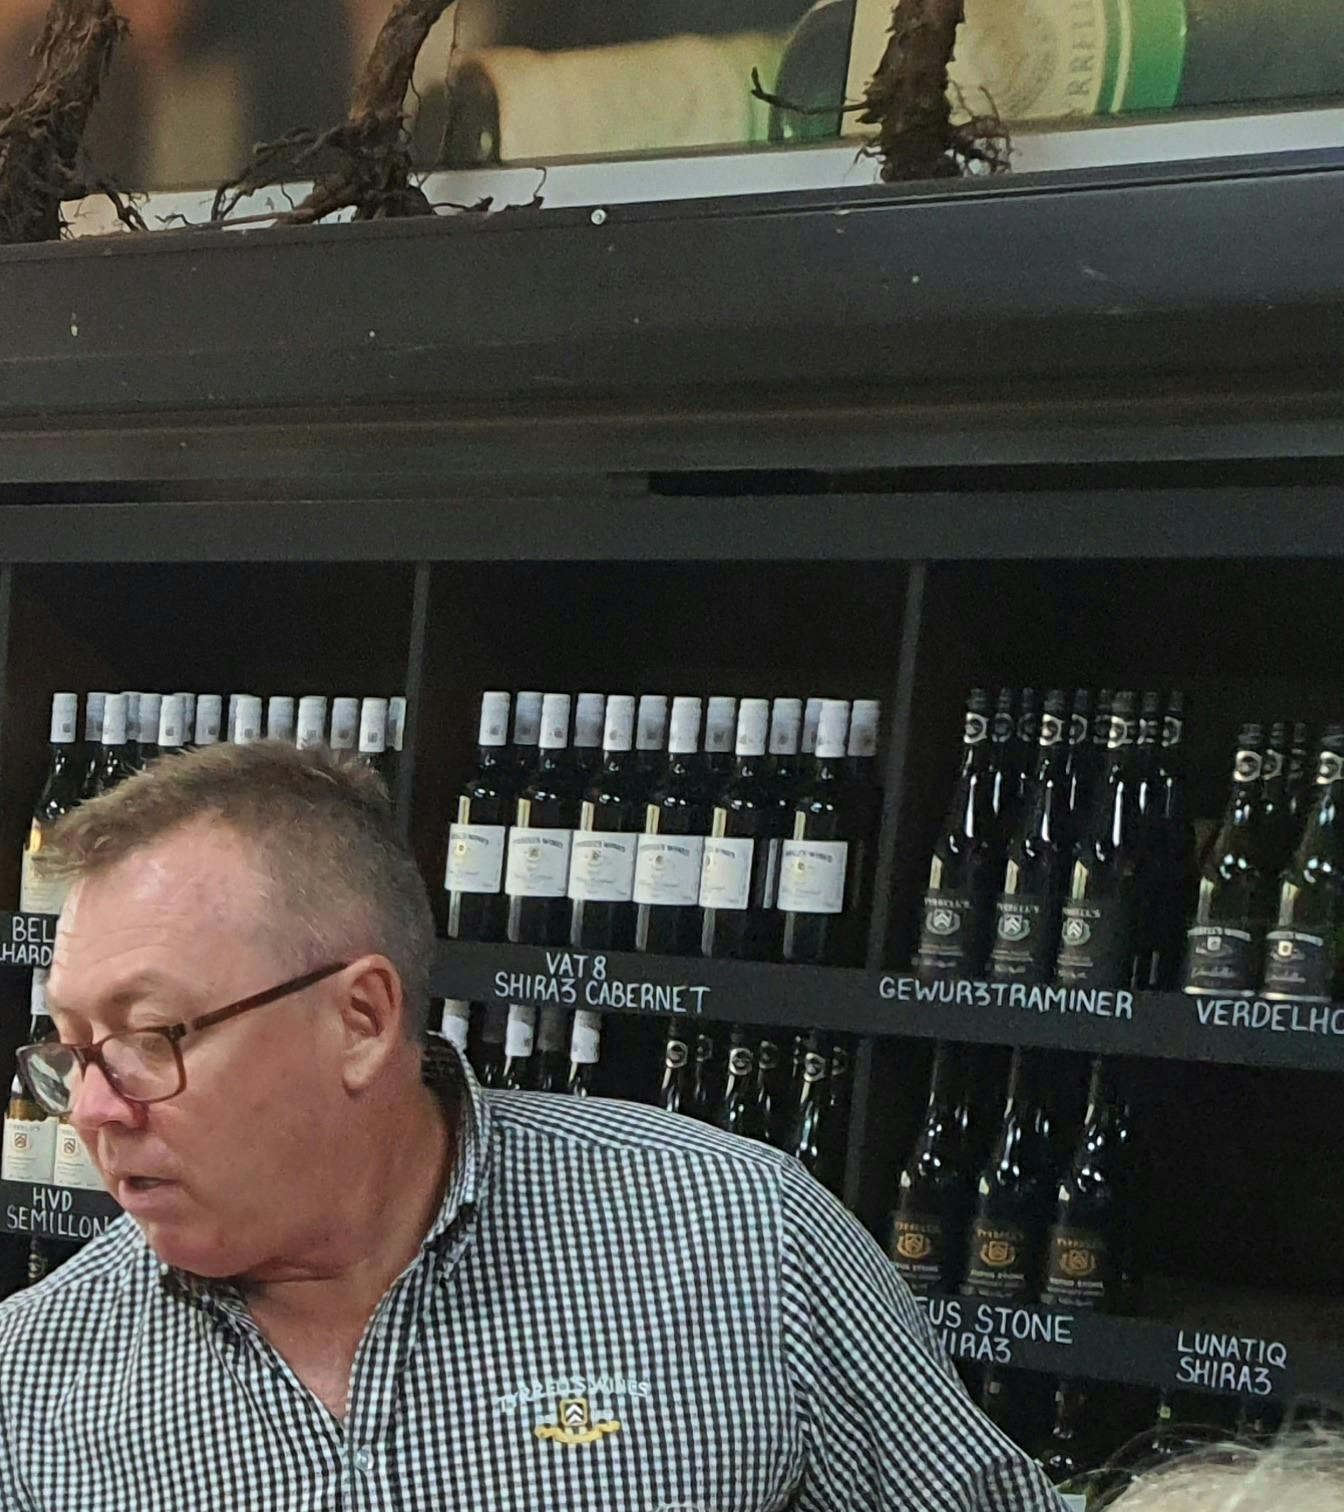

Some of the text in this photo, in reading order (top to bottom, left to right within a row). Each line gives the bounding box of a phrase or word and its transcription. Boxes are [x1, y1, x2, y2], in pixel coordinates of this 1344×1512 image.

[12, 917, 55, 944] BEL
[545, 952, 607, 980] VAT 8
[585, 980, 712, 1014] CABERNET
[32, 1187, 73, 1211] HVD
[7, 1204, 109, 1239] SEMILLON
[975, 1304, 1074, 1344] STONE
[1177, 1330, 1287, 1369] LUNATIQ
